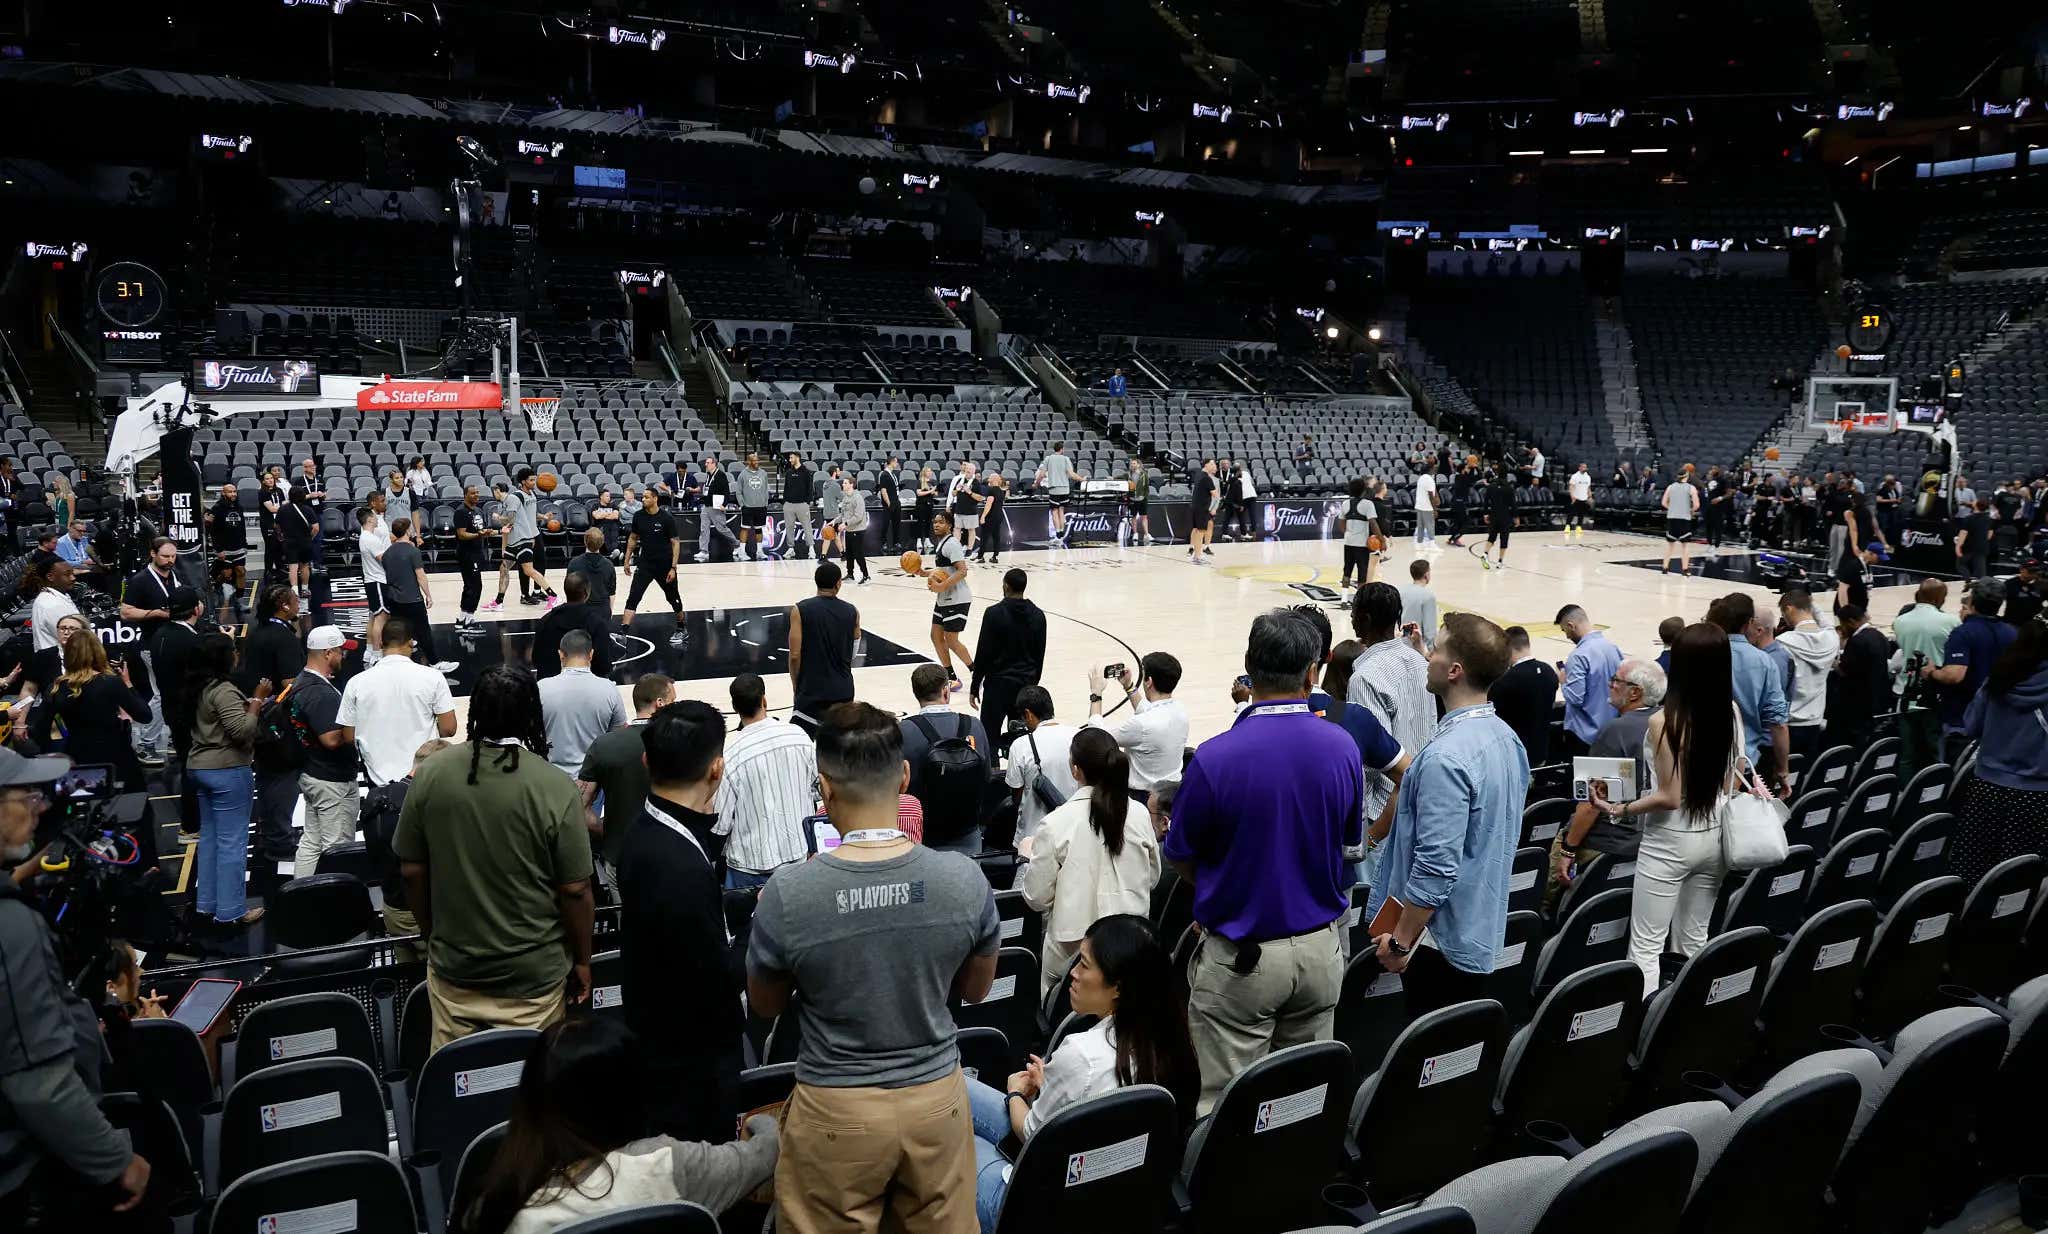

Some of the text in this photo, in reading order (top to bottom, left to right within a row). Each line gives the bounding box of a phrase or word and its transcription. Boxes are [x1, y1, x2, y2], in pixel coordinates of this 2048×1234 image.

[615, 30, 648, 44] Finals
[810, 54, 839, 68] Finals
[1053, 85, 1077, 99] Finals
[1844, 105, 1875, 120] Finals
[1408, 117, 1434, 129] Finals
[208, 136, 236, 148] Finals
[523, 142, 550, 155] Finals
[33, 246, 68, 258] Finals
[625, 272, 650, 284] Finals
[118, 282, 143, 297] 3.7
[119, 332, 162, 340] TISSOT
[215, 365, 276, 390] Finals
[172, 493, 191, 508] GET
[172, 508, 193, 523] THE
[1272, 507, 1317, 534] Finals
[179, 525, 198, 542] App
[1062, 512, 1112, 540] Finals
[1906, 531, 1944, 547] Finals
[329, 576, 368, 601] ULTRA
[849, 882, 910, 911] PLAYOFFS
